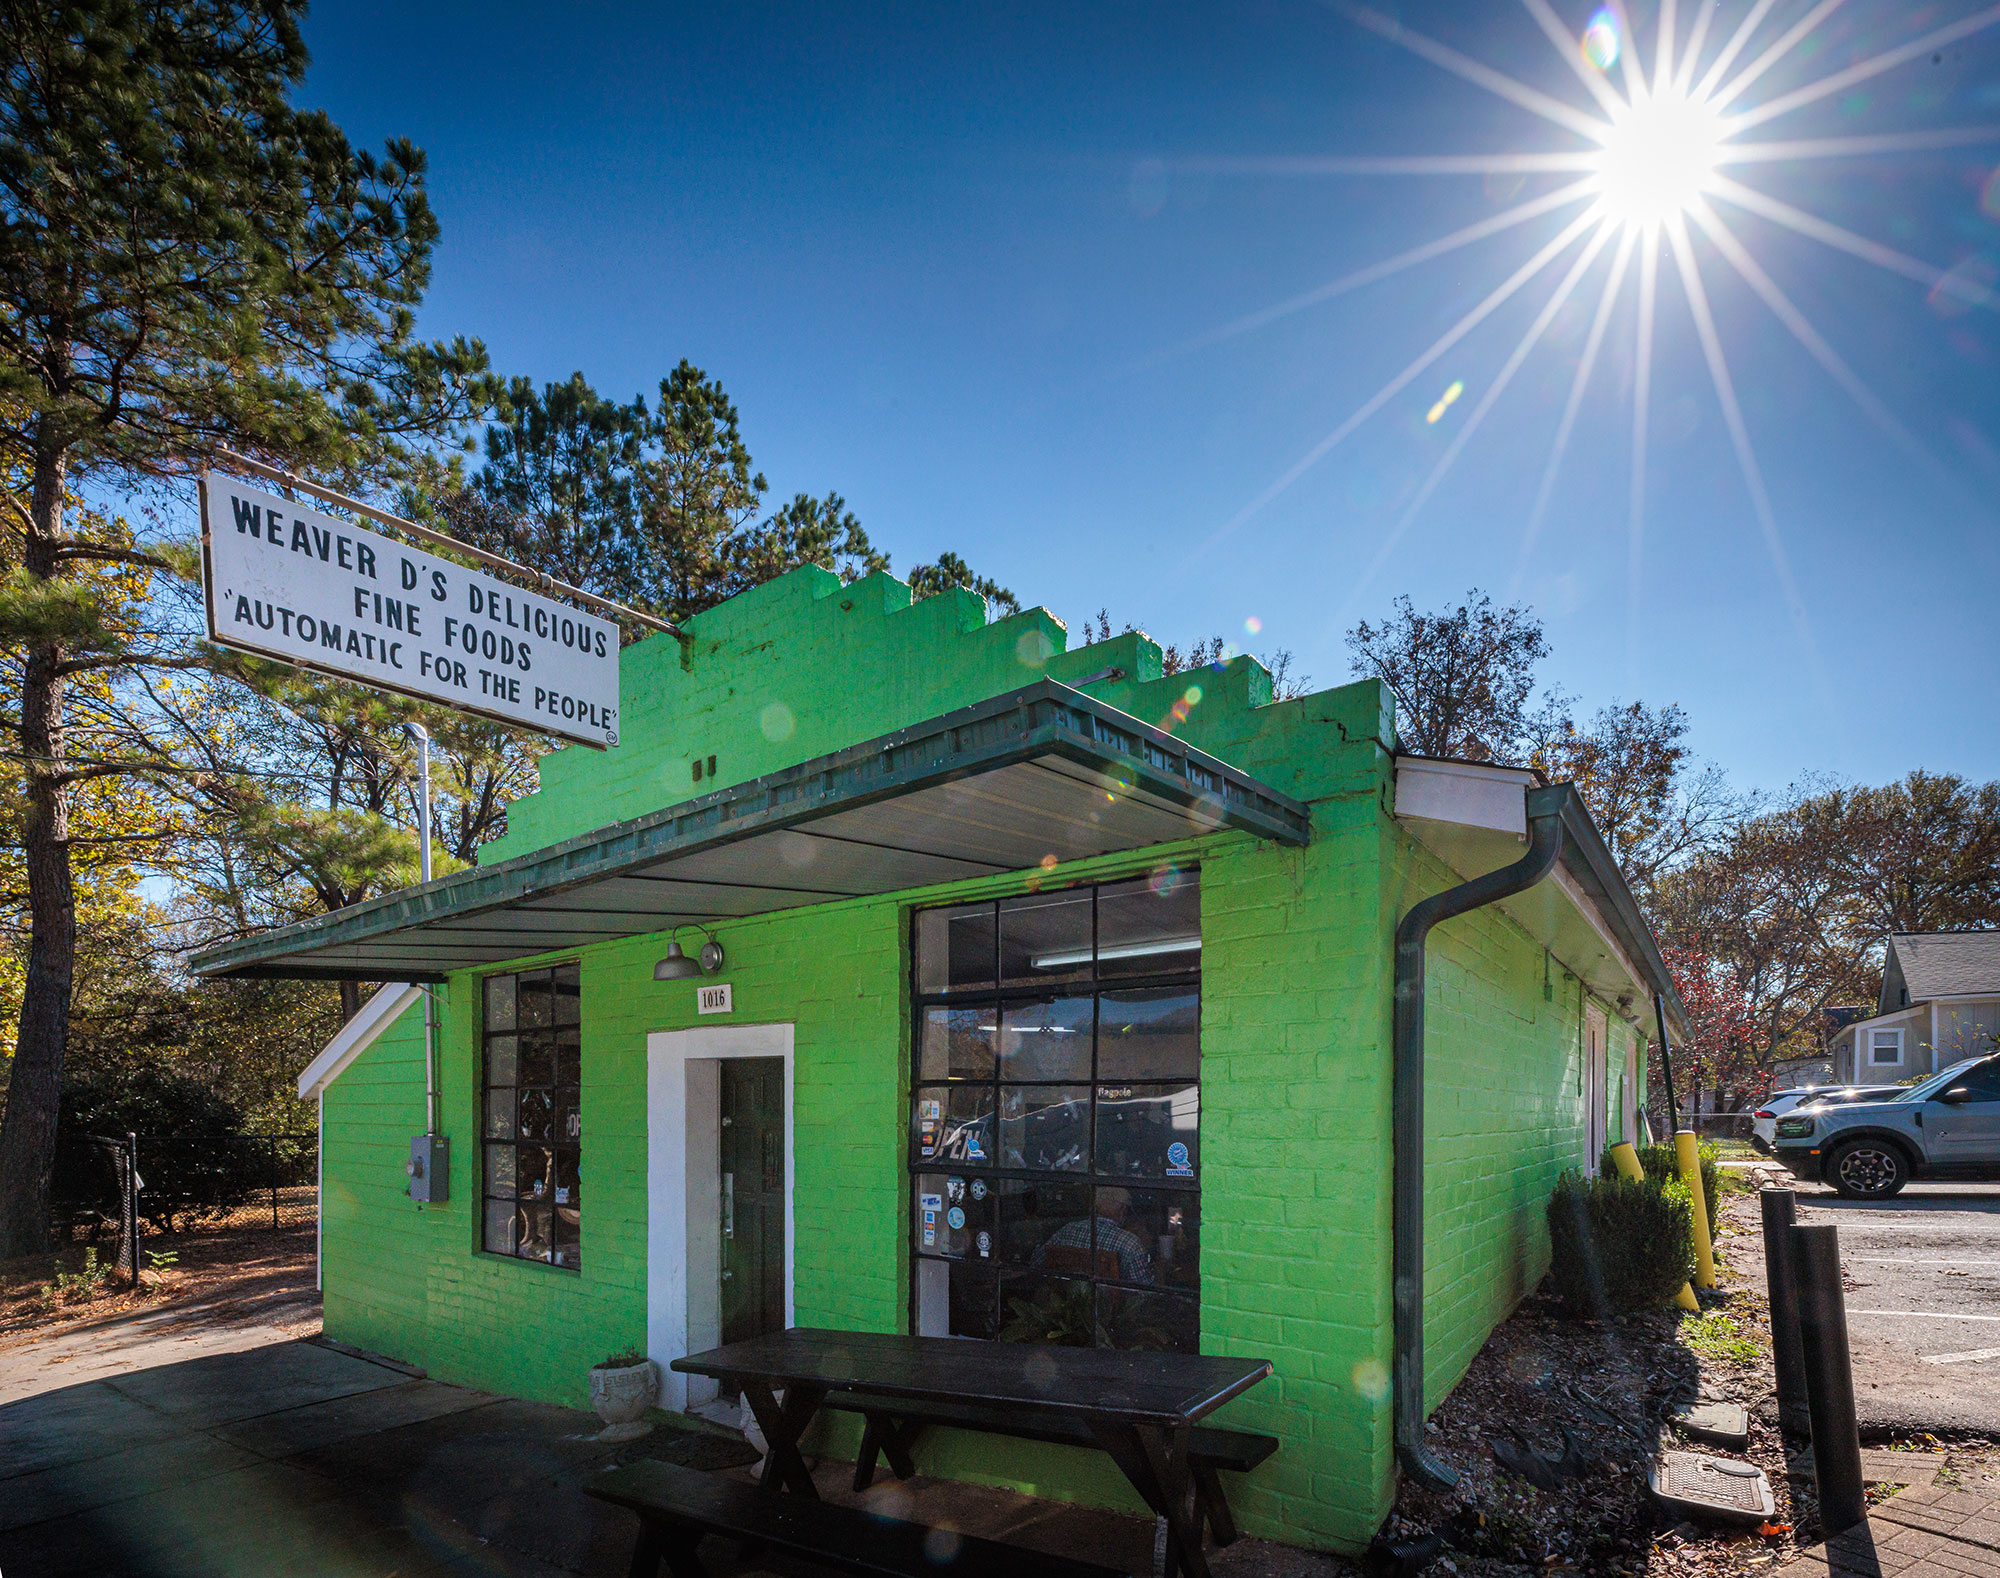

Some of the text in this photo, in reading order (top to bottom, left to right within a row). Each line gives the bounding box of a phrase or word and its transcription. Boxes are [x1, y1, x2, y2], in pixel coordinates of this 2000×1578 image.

[231, 496, 607, 658] WEAVER D'S DELICIOUS
[224, 588, 403, 669] "AUTOMATIC
[420, 650, 468, 689] FOR
[479, 669, 520, 704] THE
[354, 586, 531, 671] FINE FOODS
[703, 990, 725, 1008] 1016
